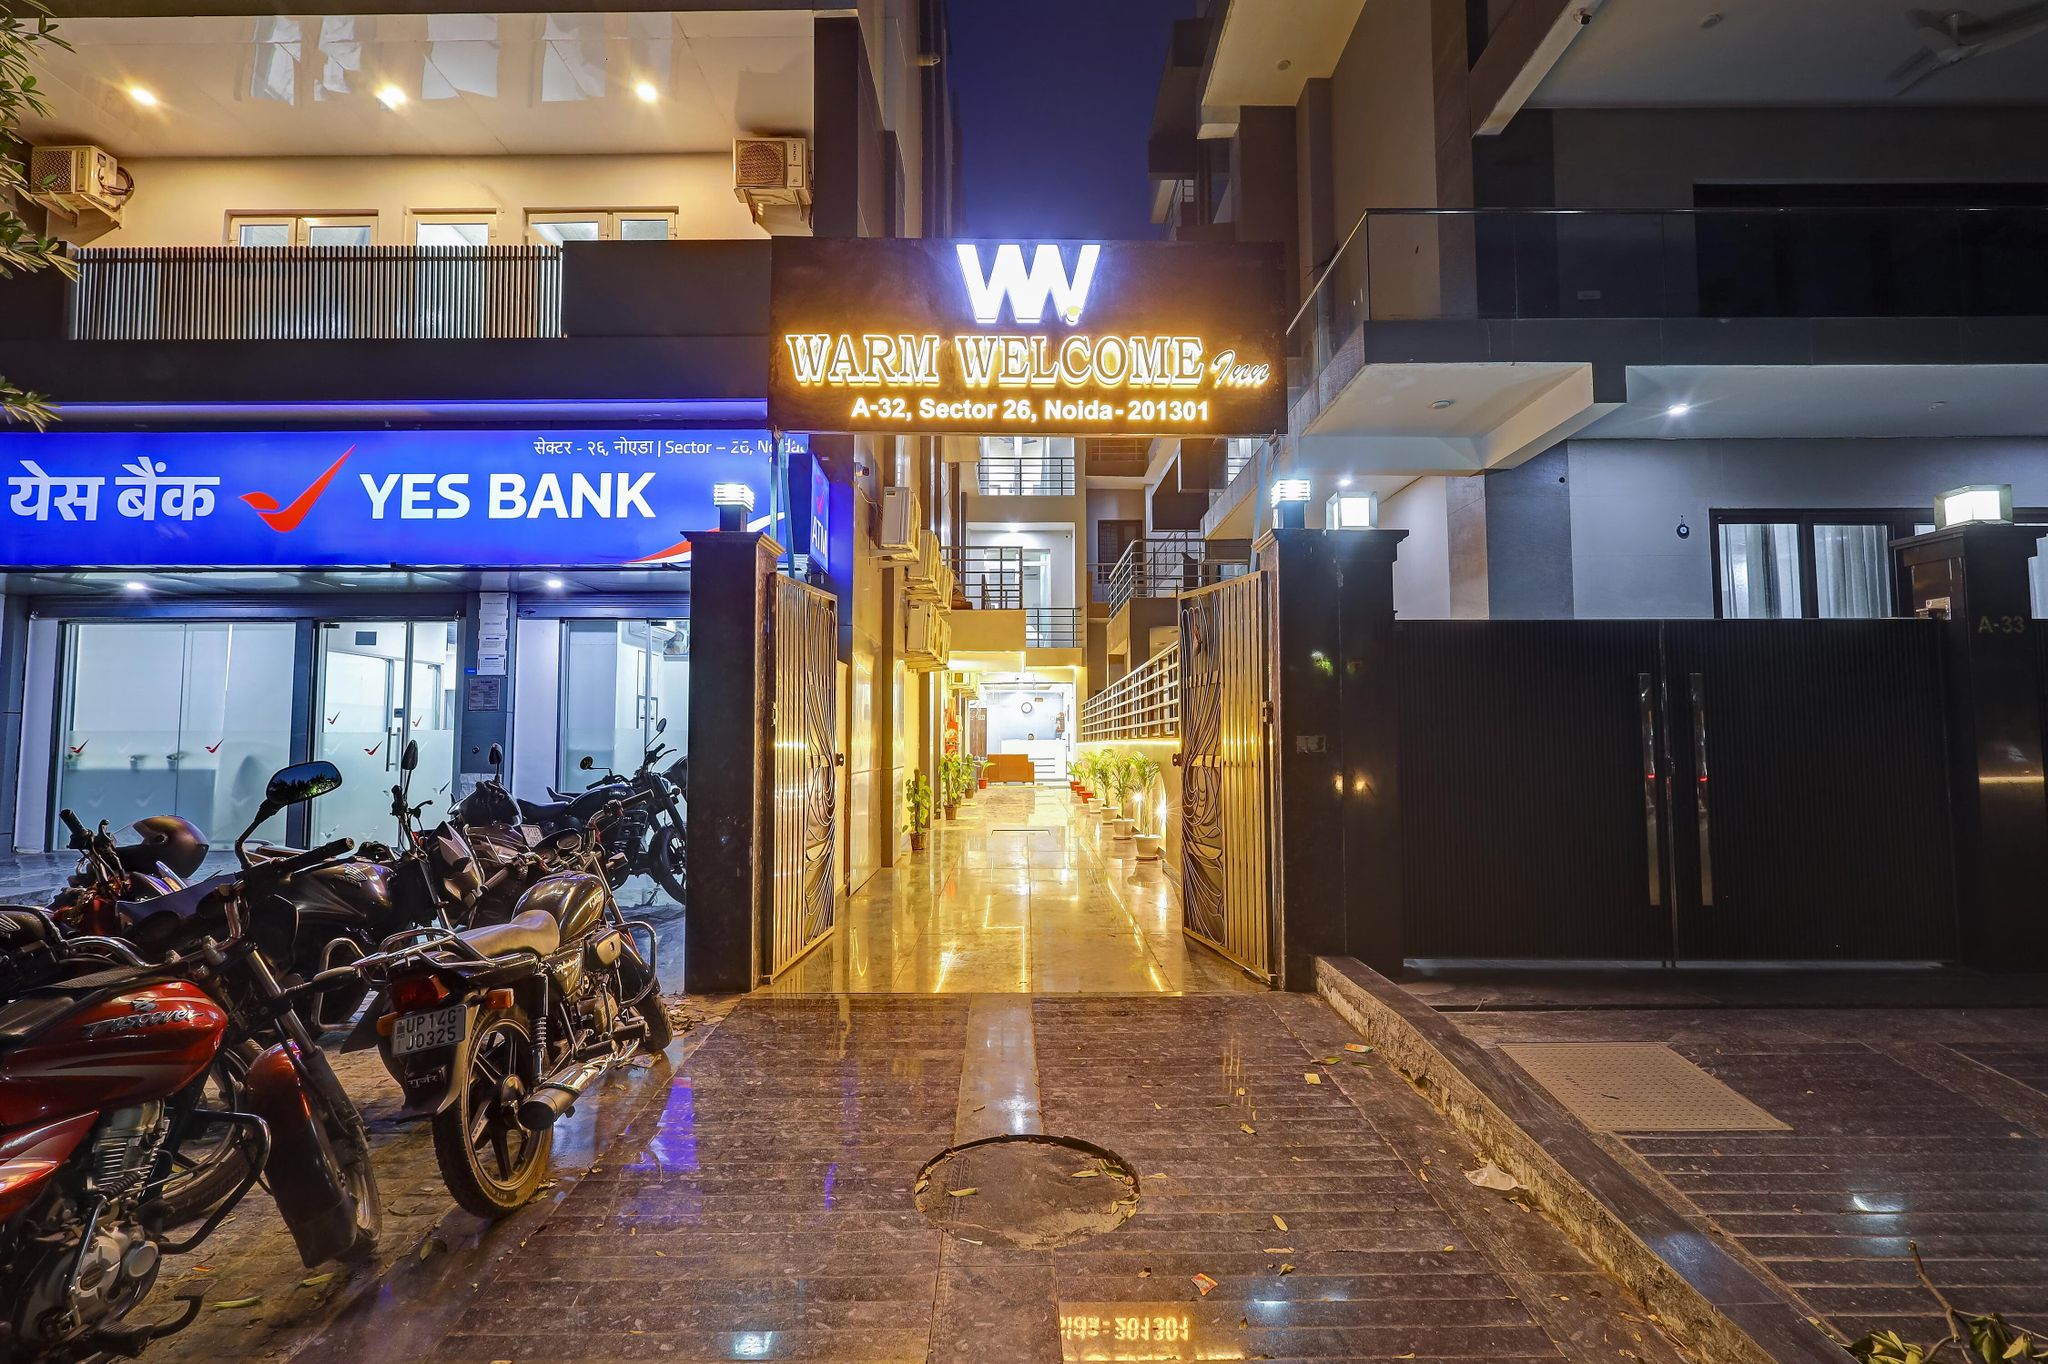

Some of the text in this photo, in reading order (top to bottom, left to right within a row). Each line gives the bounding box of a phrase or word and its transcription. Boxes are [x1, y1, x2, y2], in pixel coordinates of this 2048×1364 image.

[785, 334, 1270, 388] WARM WELCOME Inn
[850, 397, 912, 421] A-32,
[919, 397, 998, 420] Sector
[1002, 398, 1037, 423] 26,
[533, 436, 573, 455] सेक्टर
[613, 436, 655, 457] नोएडा
[665, 439, 713, 455] Sector
[731, 440, 753, 456] 26,
[8, 456, 221, 521] येस बैंक
[359, 472, 657, 519] YES BANK
[1978, 615, 2025, 634] A-33
